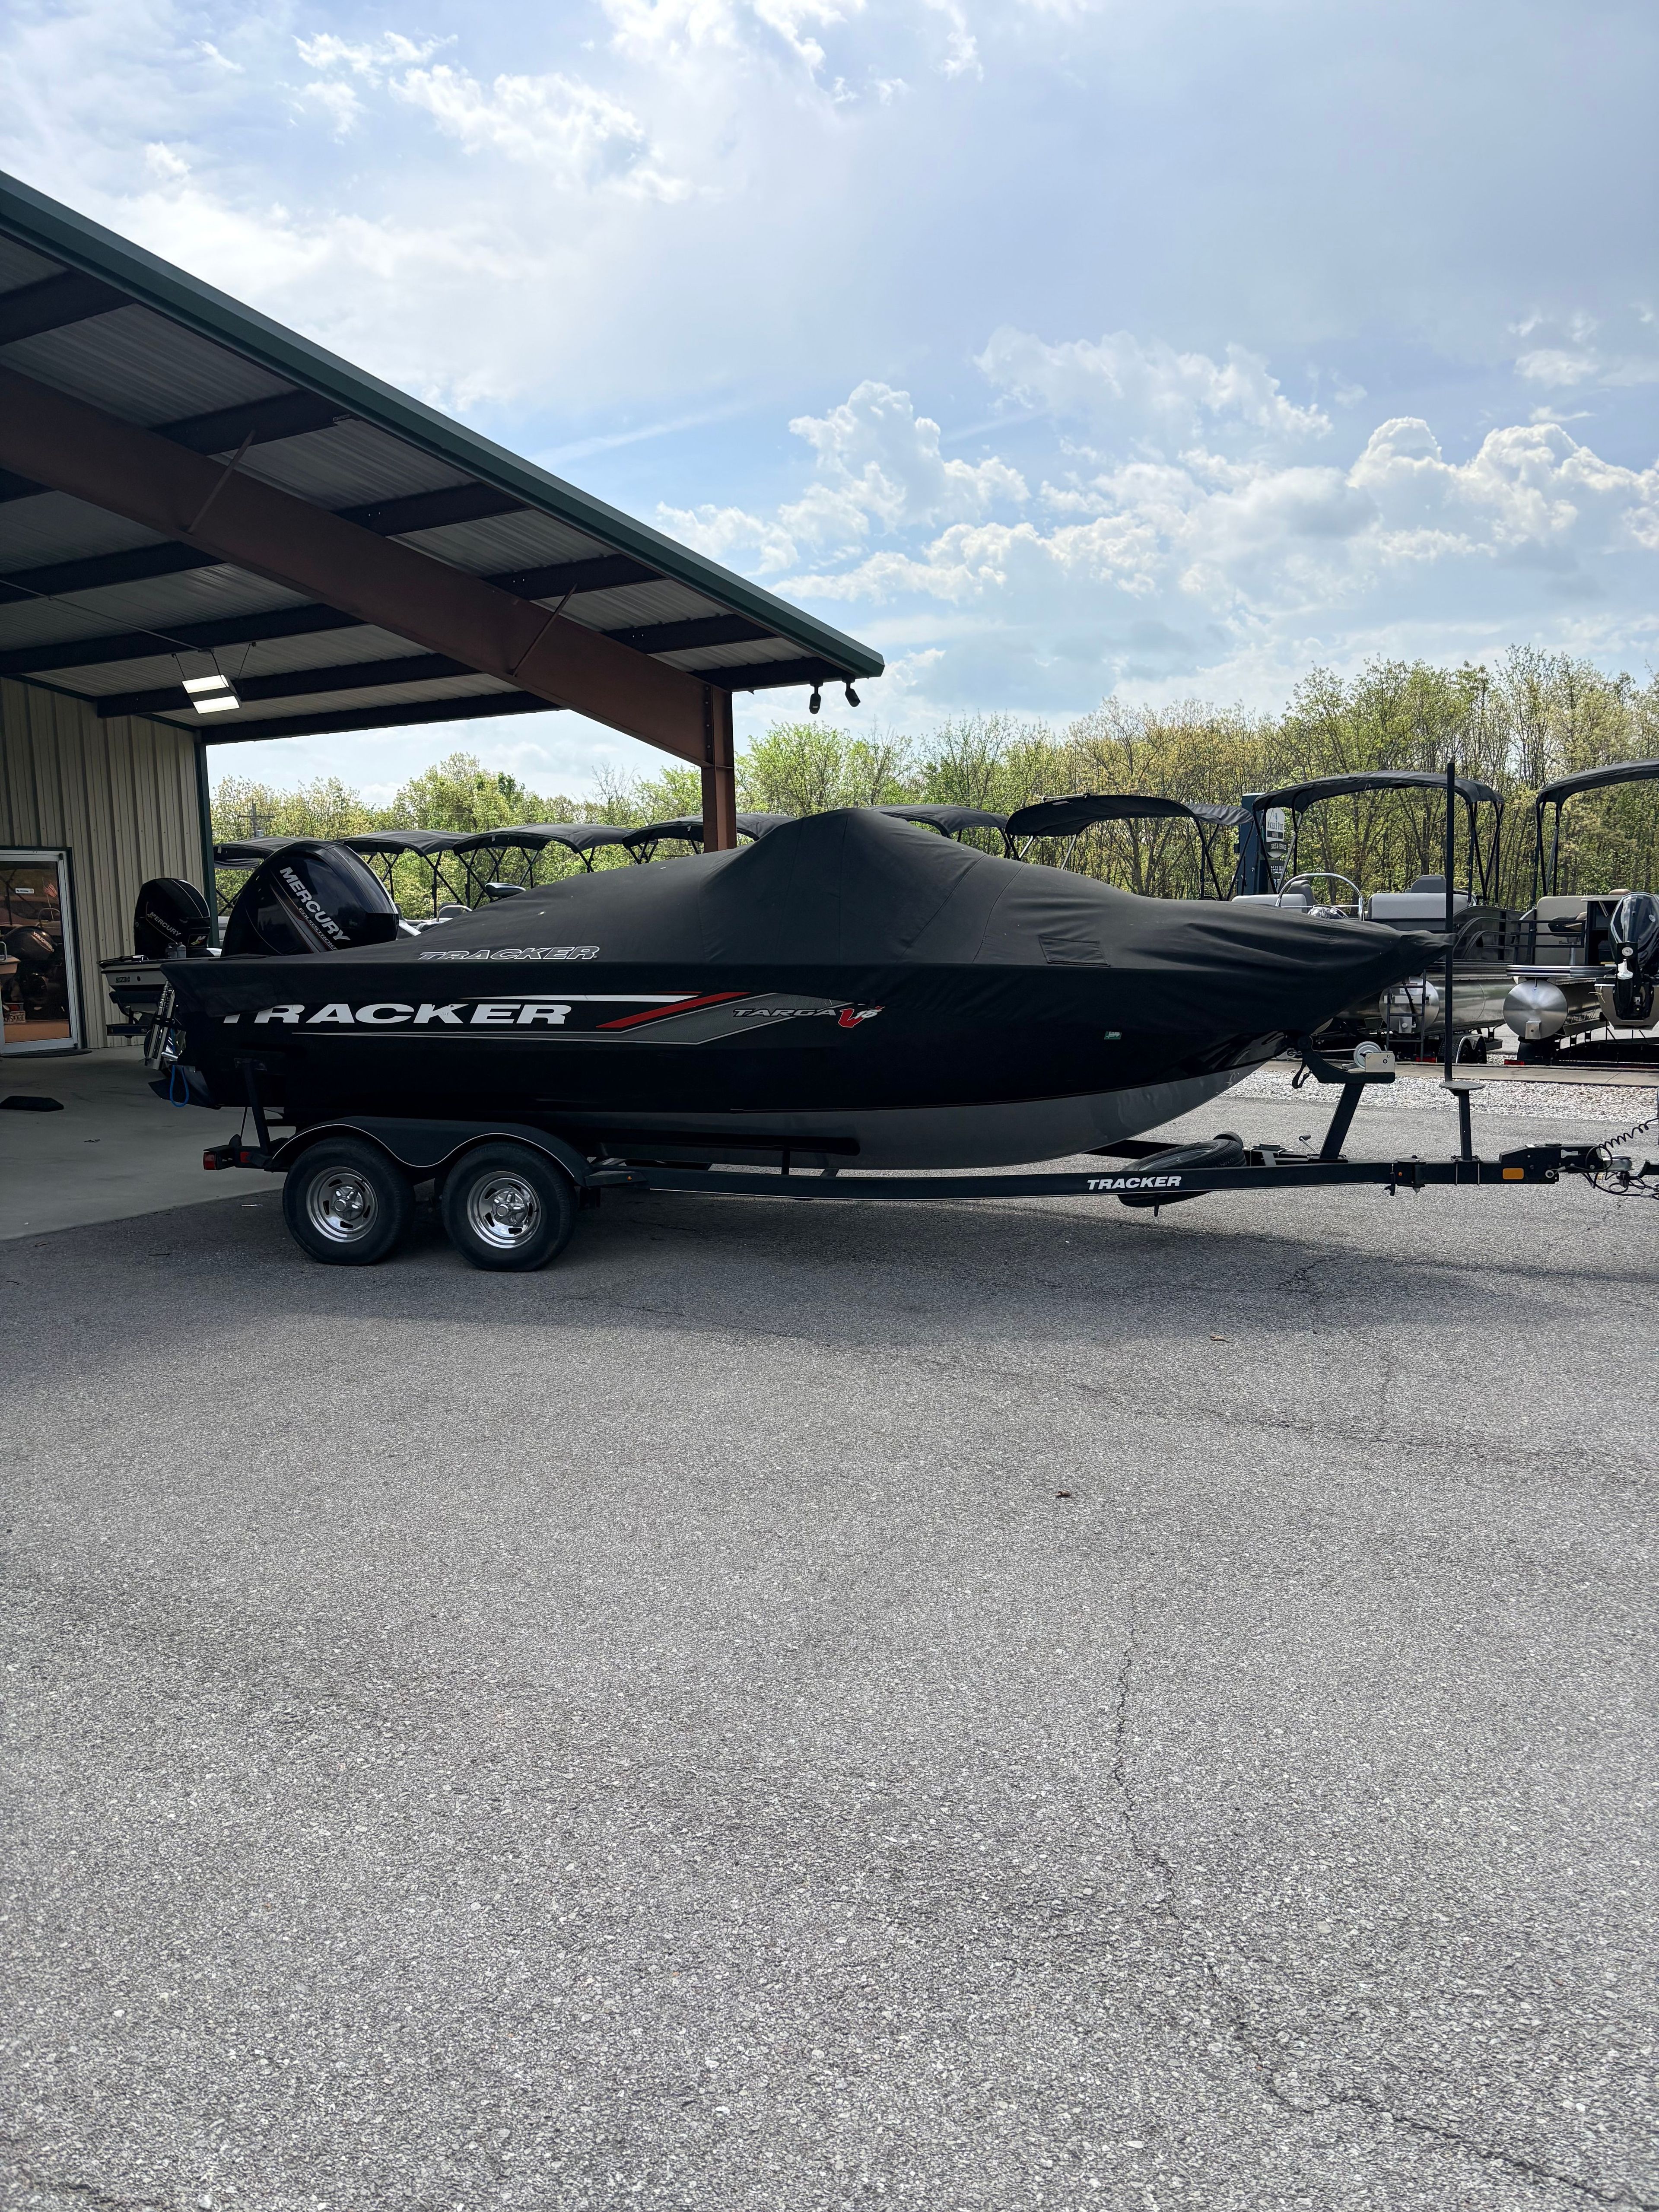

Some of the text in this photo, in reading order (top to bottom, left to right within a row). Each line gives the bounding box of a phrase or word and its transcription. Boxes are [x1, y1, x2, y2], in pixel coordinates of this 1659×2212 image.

[280, 867, 351, 940] MERCURY
[150, 912, 181, 936] MERCURY
[417, 946, 600, 960] TRACKER
[1087, 1176, 1182, 1190] TRACKER
